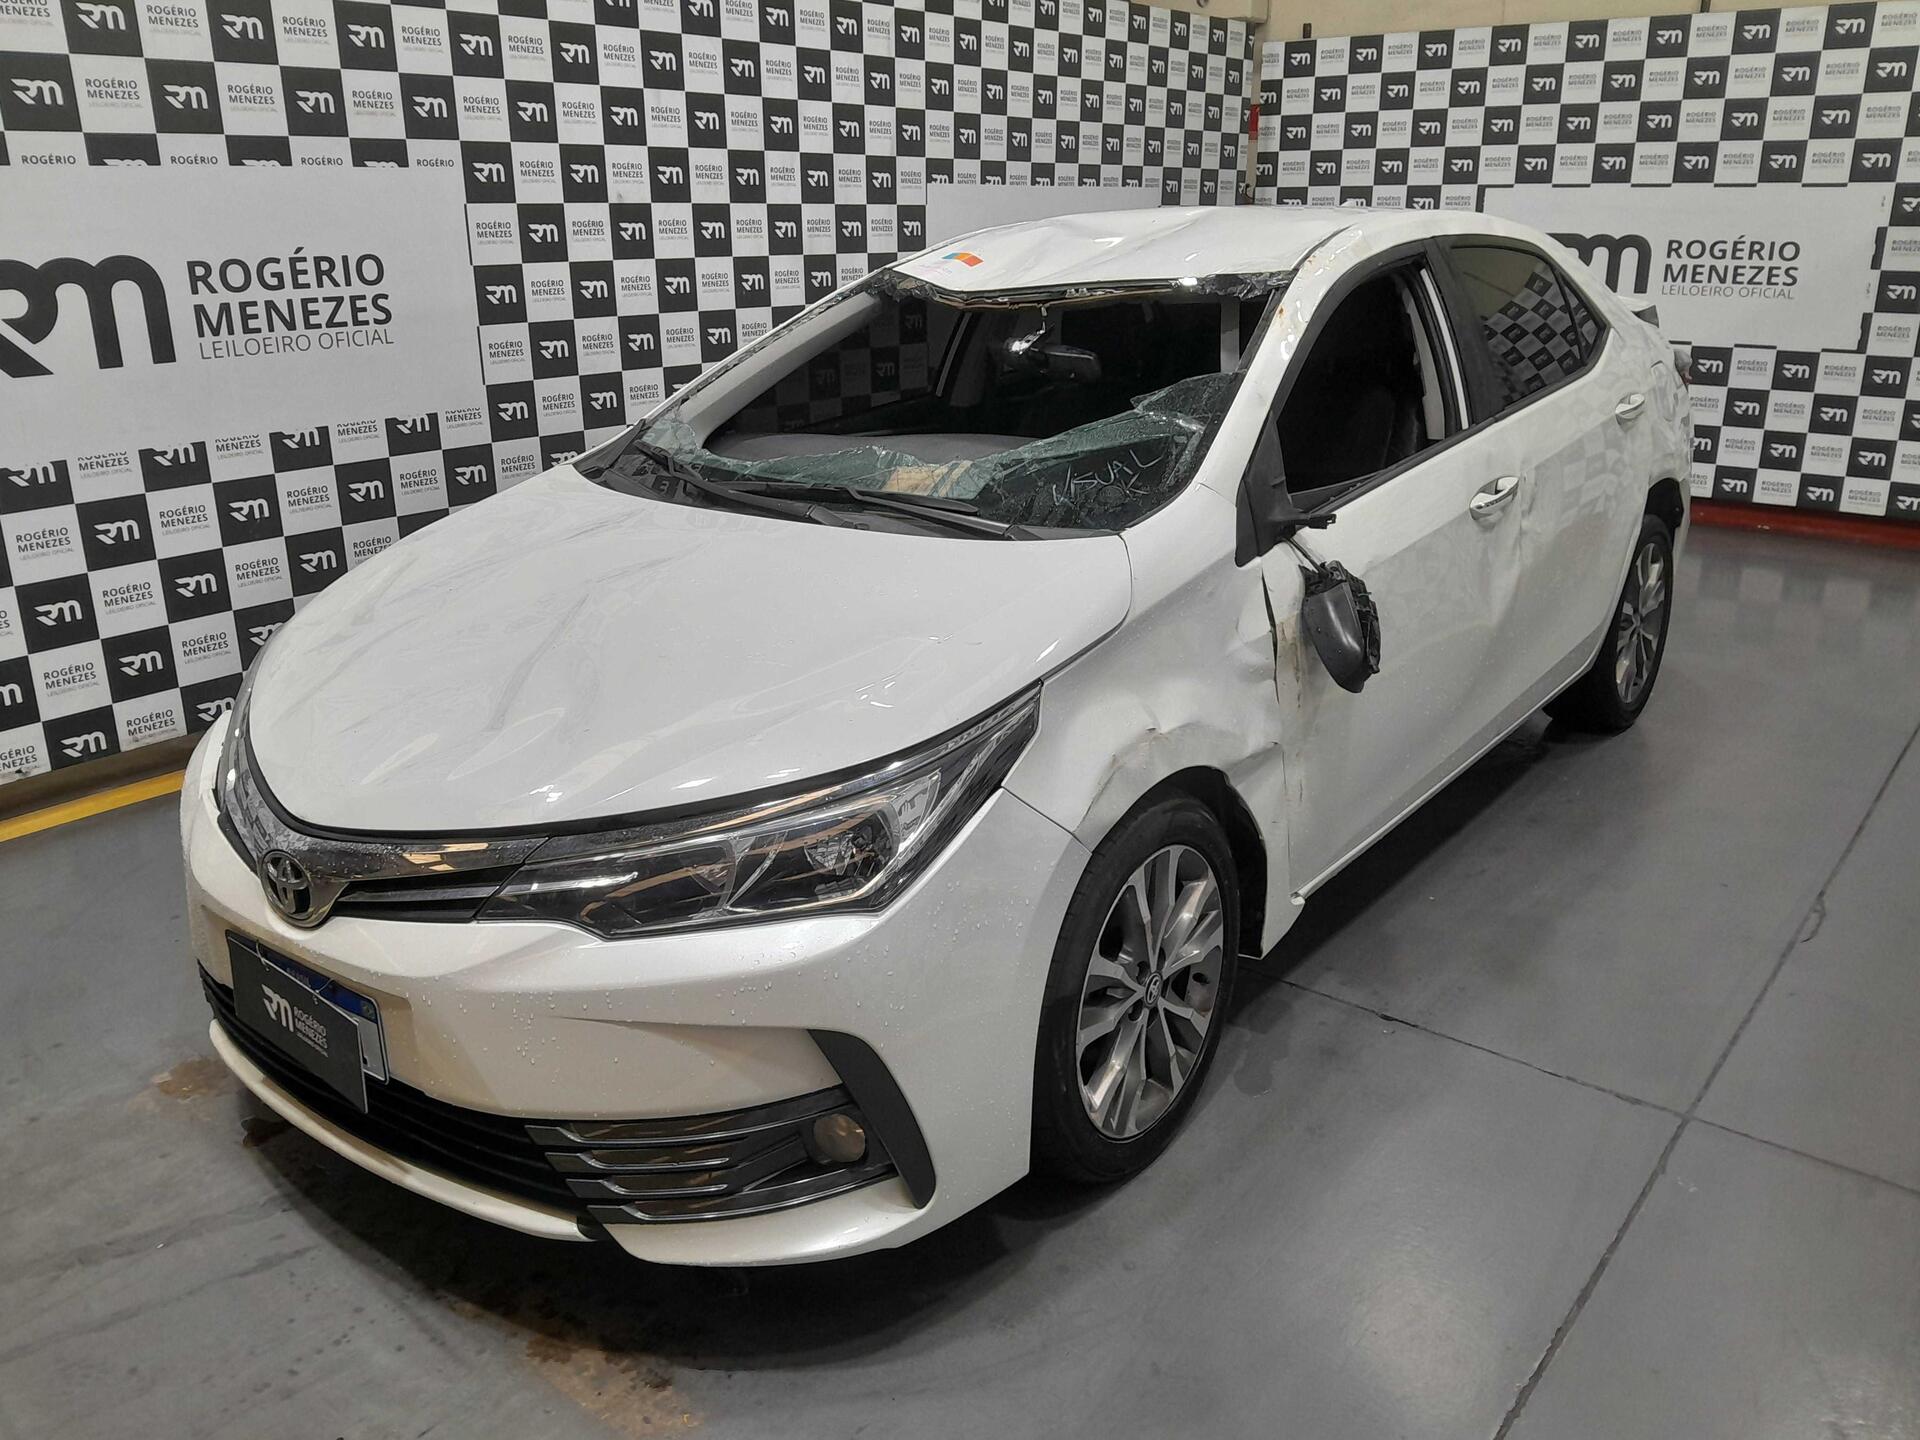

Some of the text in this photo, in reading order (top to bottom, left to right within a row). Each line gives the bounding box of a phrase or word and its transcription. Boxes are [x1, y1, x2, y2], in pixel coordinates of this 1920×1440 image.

[147, 5, 196, 17] ROGÉRIO
[148, 16, 198, 27] MENEZES
[282, 16, 325, 27] ROGÉRIO
[283, 26, 327, 37] MENEZES
[401, 26, 440, 36] ROGÉRIO
[402, 35, 441, 45] MENEZES
[508, 35, 542, 45] ROGÉRIO
[509, 44, 543, 54] MENEZES
[603, 44, 634, 53] ROGÉRIO
[604, 53, 635, 61] MENEZES
[689, 52, 716, 61] ROGÉRIO
[689, 60, 717, 68] MENEZES
[766, 59, 791, 67] ROGÉRIO
[766, 67, 791, 75] MENEZES
[85, 78, 137, 89] ROGÉRIO
[87, 89, 139, 99] MENEZES
[227, 84, 272, 94] ROGÉRIO
[228, 95, 274, 104] MENEZES
[352, 90, 392, 99] ROGÉRIO
[353, 100, 394, 109] MENEZES
[463, 95, 498, 105] ROGÉRIO
[464, 105, 500, 113] MENEZES
[562, 101, 594, 110] ROGÉRIO
[651, 106, 679, 114] ROGÉRIO
[563, 110, 595, 118] MENEZES
[731, 111, 757, 119] ROGÉRIO
[21, 154, 75, 164] ROGÉRIO
[170, 154, 218, 164] ROGÉRIO
[301, 156, 343, 165] ROGÉRIO
[416, 158, 453, 166] ROGÉRIO
[520, 160, 553, 168] ROGÉRIO
[612, 161, 642, 169] ROGÉRIO
[476, 221, 510, 229] ROGÉRIO
[572, 219, 603, 228] ROGÉRIO
[658, 218, 686, 226] ROGÉRIO
[477, 230, 512, 238] MENEZES
[573, 228, 604, 236] MENEZES
[1666, 235, 1800, 262] ROGÉRIO
[186, 247, 385, 295] ROGÉRIO
[701, 272, 728, 280] ROGÉRIO
[1663, 263, 1799, 287] MENEZES
[531, 279, 563, 287] ROGÉRIO
[621, 275, 650, 283] ROGÉRIO
[532, 287, 564, 296] MENEZES
[621, 283, 651, 291] MENEZES
[1661, 284, 1795, 300] LEILOEIRO OFICIAL
[193, 294, 392, 338] MENEZES
[666, 327, 693, 335] ROGÉRIO
[582, 333, 612, 342] ROGÉRIO
[666, 334, 694, 343] MENEZES
[199, 328, 394, 360] LEILOEIRO OFICIAL
[489, 340, 522, 350] ROGÉRIO
[583, 341, 613, 350] MENEZES
[489, 348, 523, 358] MENEZES
[630, 383, 658, 392] ROGÉRIO
[542, 393, 573, 402] ROGÉRIO
[630, 391, 659, 400] MENEZES
[543, 400, 574, 410] MENEZES
[446, 412, 481, 422] MENEZES
[338, 424, 377, 436] MENEZES
[216, 439, 261, 452] MENEZES
[79, 457, 129, 470] MENEZES
[501, 454, 533, 465] ROGÉRIO
[502, 462, 535, 473] MENEZES
[400, 468, 436, 480] ROGÉRIO
[401, 477, 437, 488] MENEZES
[287, 485, 327, 498] ROGÉRIO
[288, 493, 329, 506] MENEZES
[159, 504, 205, 518] ROGÉRIO
[161, 513, 208, 527] MENEZES
[16, 527, 68, 542] ROGÉRIO
[18, 537, 71, 552] MENEZES
[353, 536, 391, 549] ROGÉRIO
[235, 557, 278, 571] ROGÉRIO
[237, 565, 280, 580] MENEZES
[102, 582, 150, 597] ROGÉRIO
[104, 591, 153, 607] MENEZES
[182, 632, 226, 648] ROGÉRIO
[183, 640, 228, 657] MENEZES
[43, 662, 94, 679] ROGÉRIO
[45, 671, 96, 689] MENEZES
[126, 709, 173, 727] ROGÉRIO
[128, 717, 175, 735] MENEZES
[0, 746, 35, 761] GÉRIO
[293, 1006, 327, 1037] ROGÉRIO
[295, 1018, 328, 1049] MENEZES
